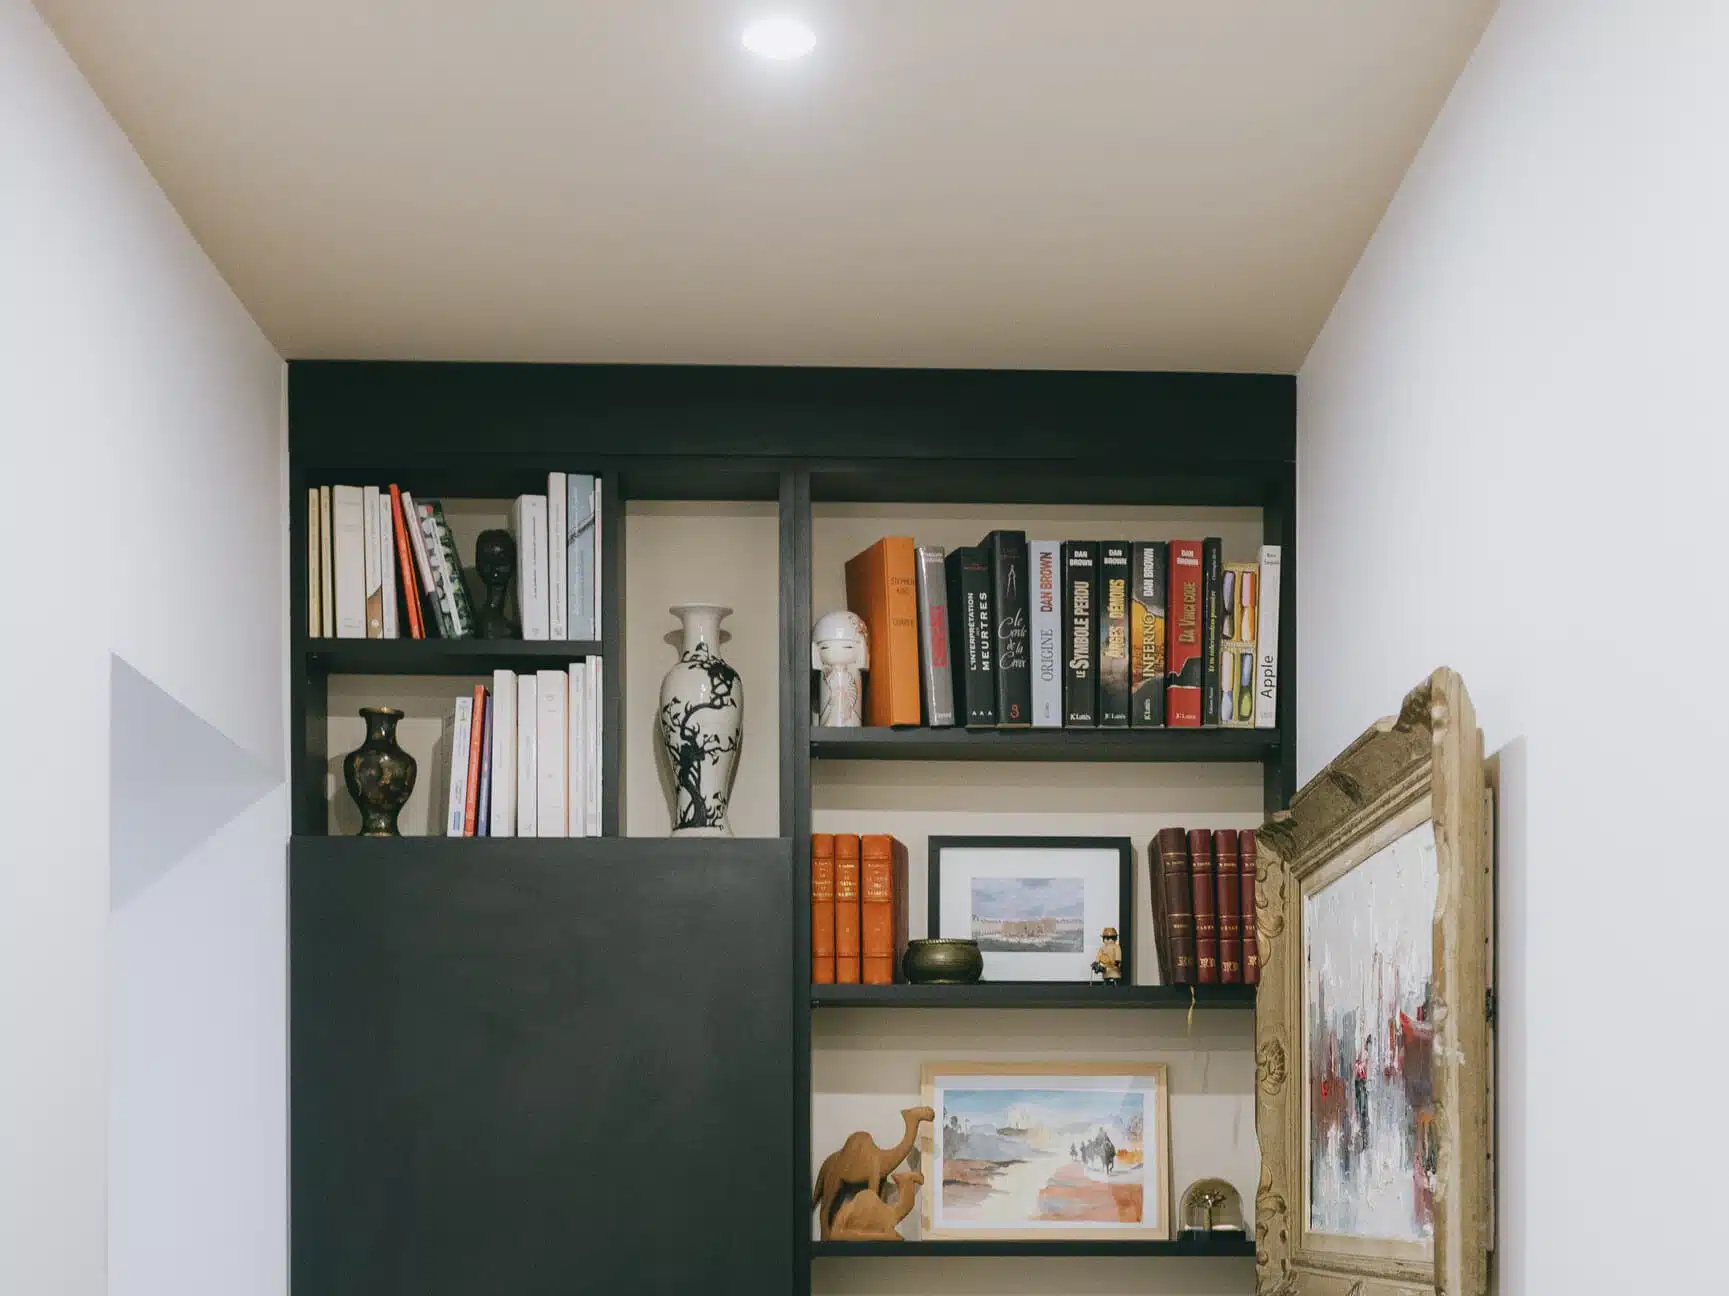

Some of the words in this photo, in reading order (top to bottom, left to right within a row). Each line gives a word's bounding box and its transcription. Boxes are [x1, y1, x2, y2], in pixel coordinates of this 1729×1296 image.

[1069, 559, 1092, 567] BROWN
[1074, 551, 1088, 559] DAN
[1104, 557, 1127, 565] BROWN
[1109, 549, 1122, 557] DAN
[1143, 548, 1154, 578] BROWN
[1177, 558, 1200, 566] BROWN
[1181, 550, 1194, 558] DAN
[1040, 551, 1052, 591] BROWN
[1074, 581, 1090, 615] PERDU
[1107, 579, 1125, 618] DÉMONS
[1143, 579, 1154, 597] DAN
[1040, 592, 1053, 612] DAN
[979, 592, 990, 671] MEURTRES
[1069, 616, 1089, 670] SYMBOLE
[1041, 628, 1054, 682] ORIGINE
[1142, 614, 1156, 677] INFERNO
[1076, 670, 1086, 678] LE
[1261, 655, 1276, 699] Apple
